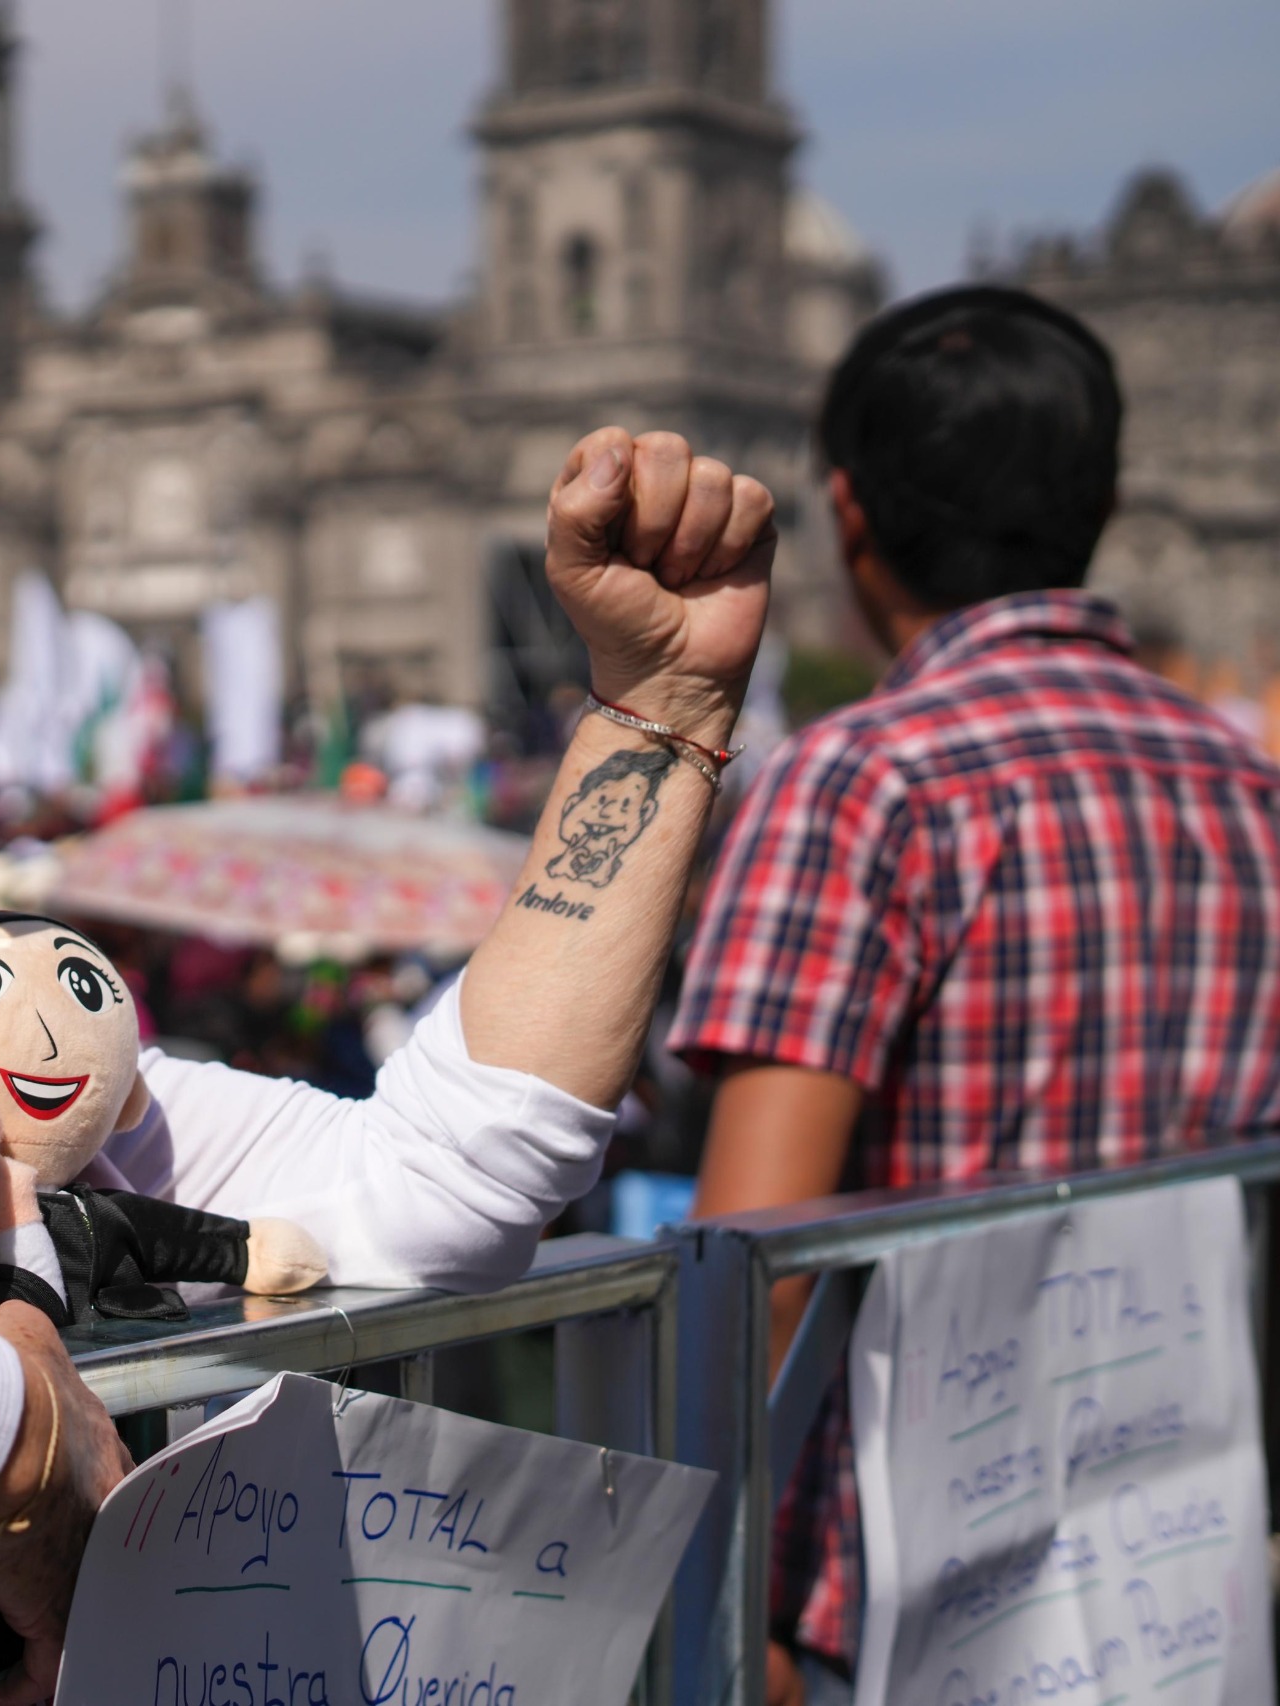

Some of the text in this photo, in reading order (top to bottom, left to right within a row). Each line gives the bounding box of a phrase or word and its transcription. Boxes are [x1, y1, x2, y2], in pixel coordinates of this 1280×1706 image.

[516, 883, 595, 920] Amlove
[331, 1471, 488, 1553] TOTAL
[536, 1541, 569, 1577] a
[155, 1630, 327, 1706] nuestra
